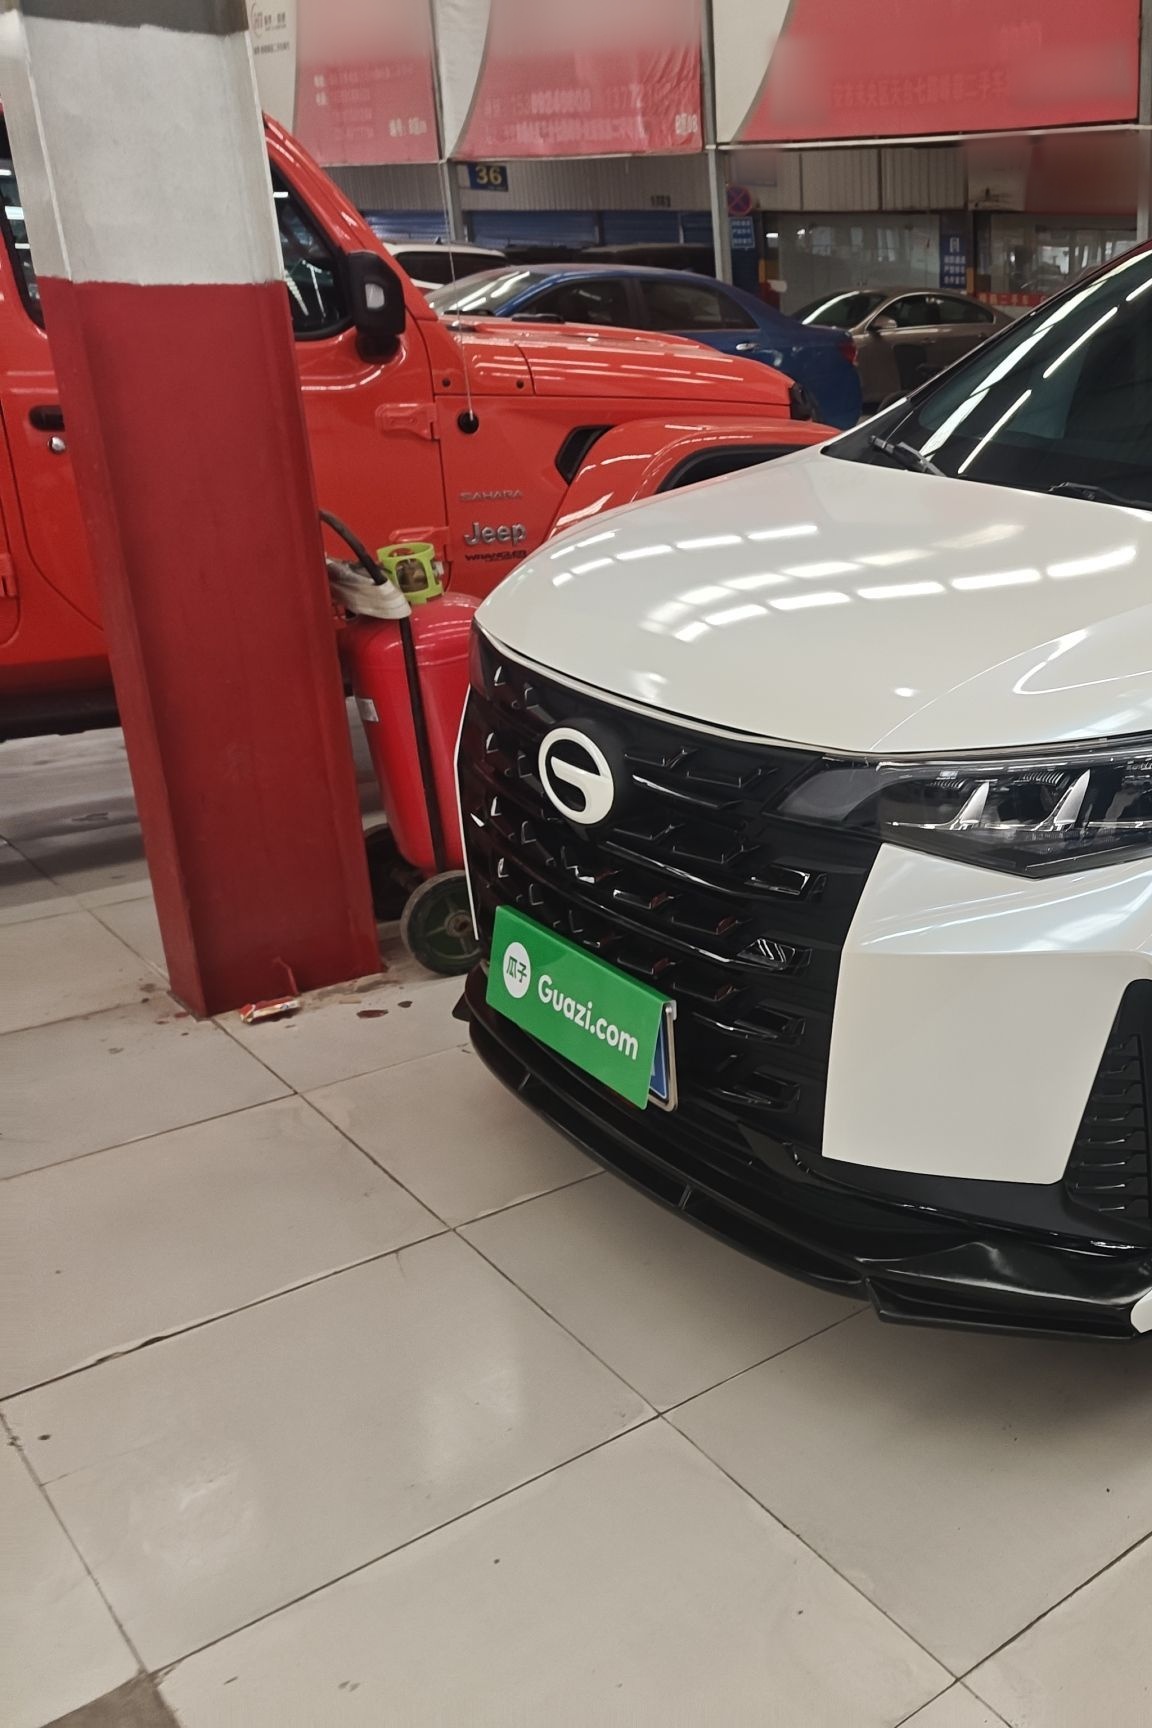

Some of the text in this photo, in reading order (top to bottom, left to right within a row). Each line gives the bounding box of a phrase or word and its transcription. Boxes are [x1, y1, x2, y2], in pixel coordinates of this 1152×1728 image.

[475, 166, 503, 185] 36
[459, 490, 522, 501] SAHARA
[464, 522, 526, 546] Jeep
[506, 956, 528, 984] 瓜子
[537, 973, 639, 1060] Guazi.com
